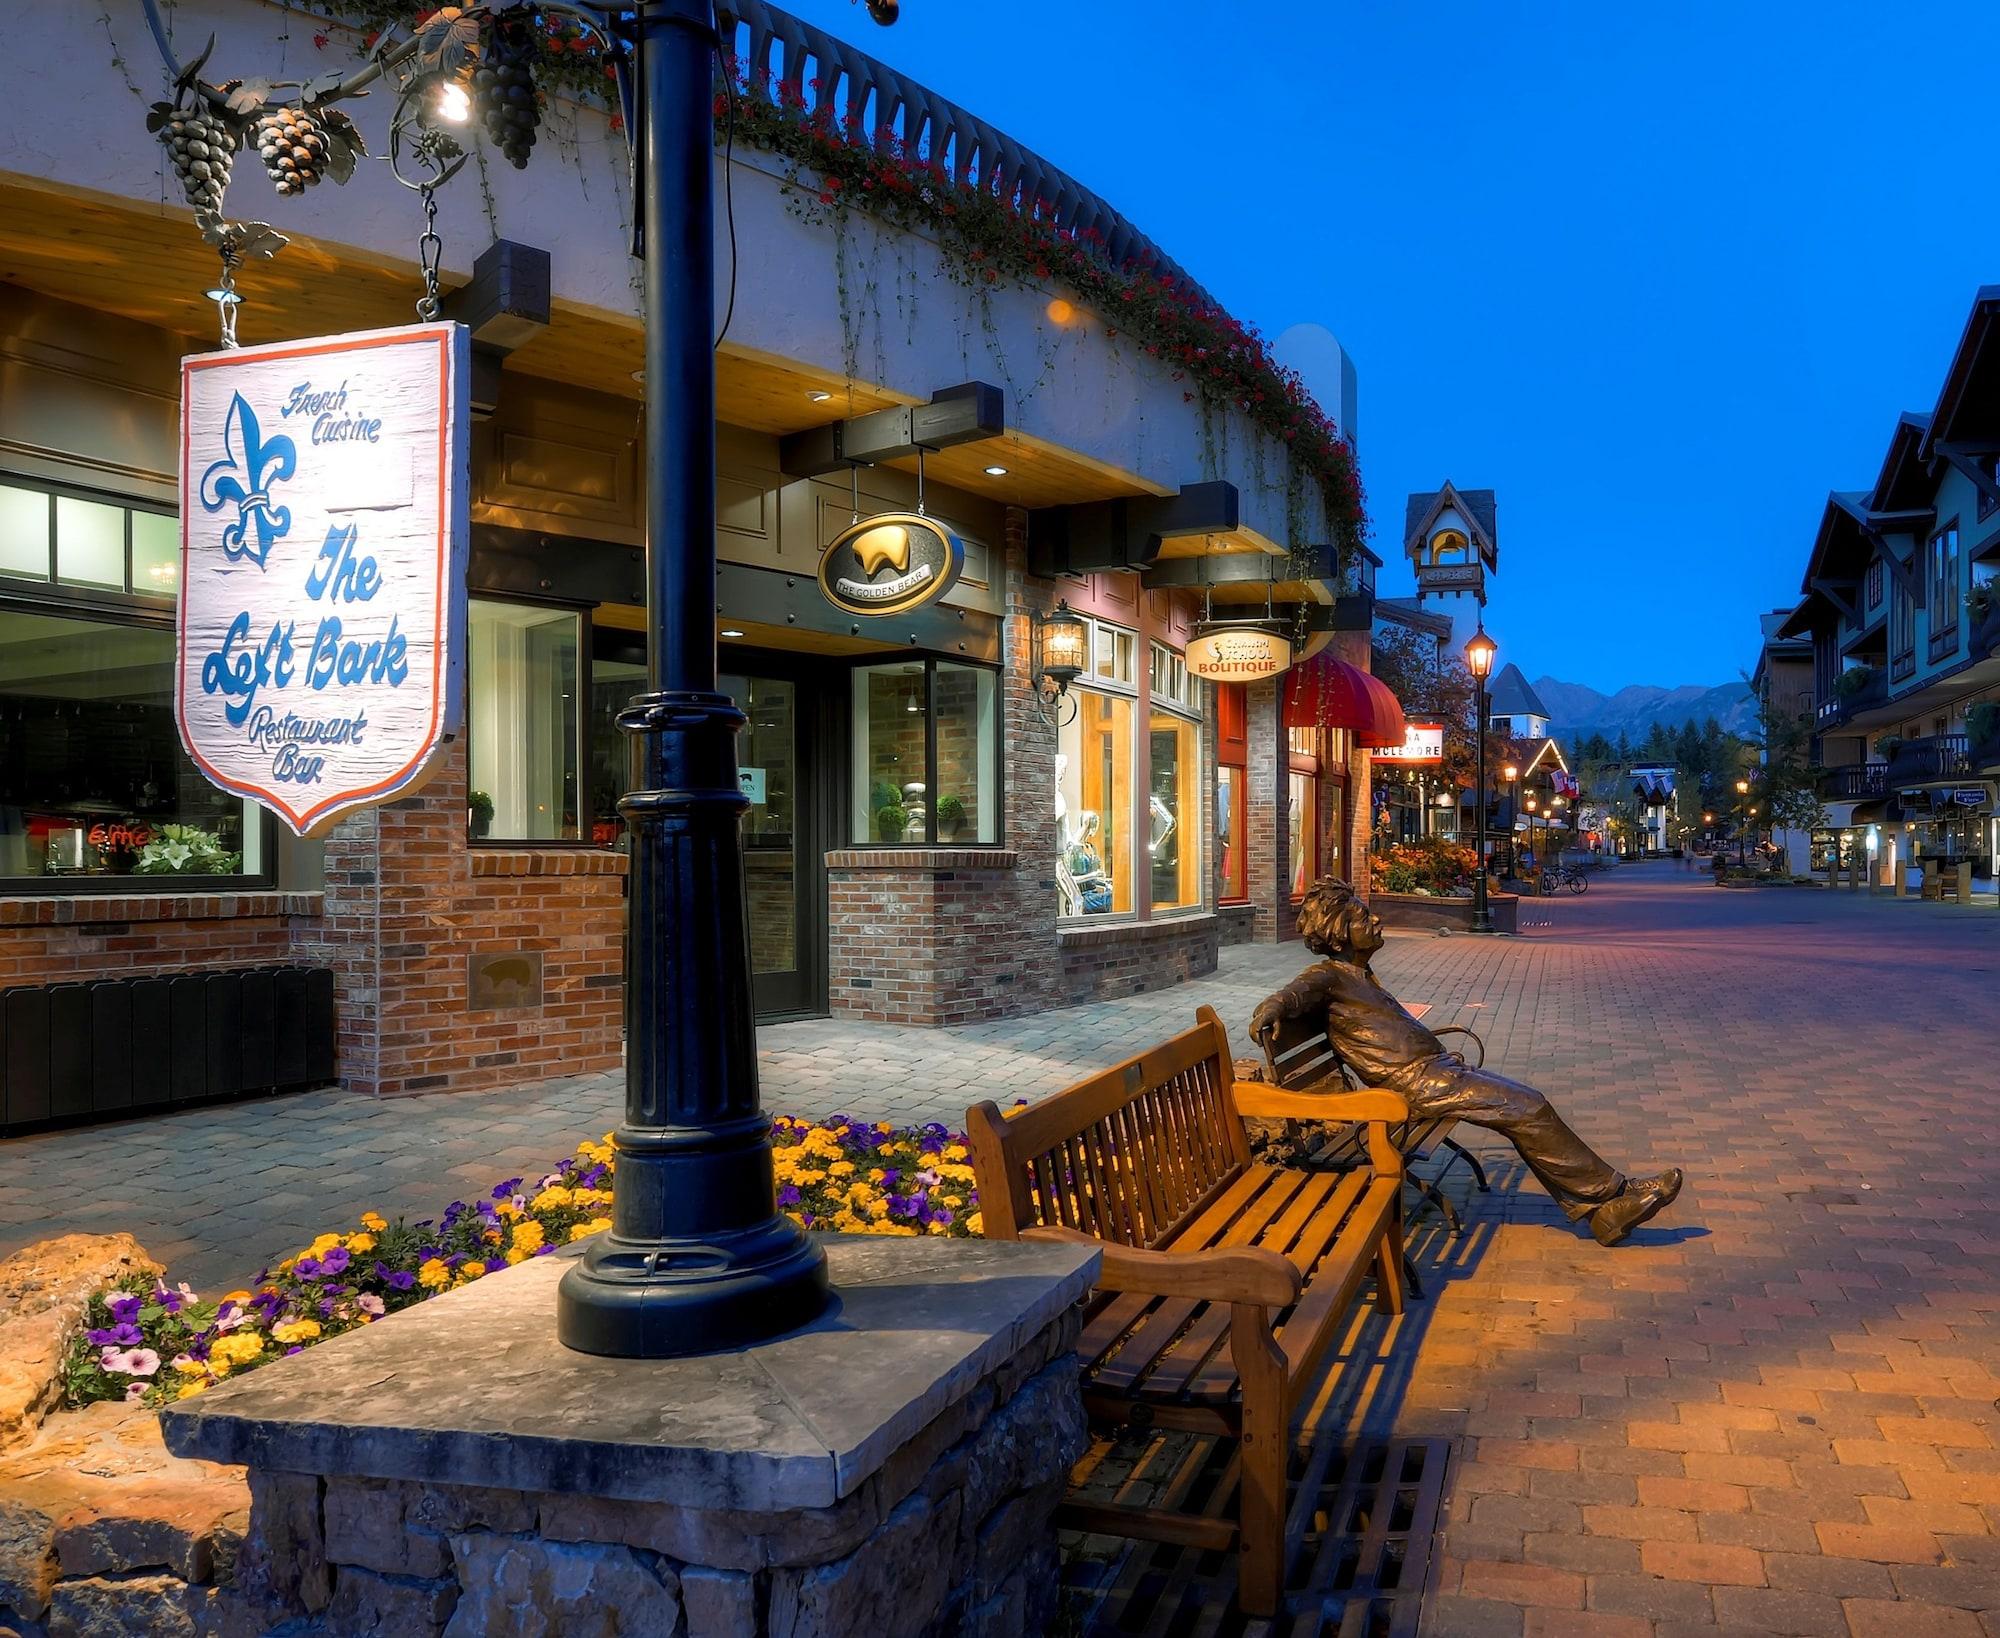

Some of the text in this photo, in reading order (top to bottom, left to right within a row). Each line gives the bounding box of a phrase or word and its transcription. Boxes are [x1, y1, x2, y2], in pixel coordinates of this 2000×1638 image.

[281, 380, 347, 419] French
[312, 411, 382, 446] Cuisine
[305, 523, 383, 603] The
[838, 572, 922, 597] THE GOLDEN BEAR
[202, 611, 408, 728] Left Bank
[1198, 661, 1277, 673] BOUTIQUE
[249, 706, 368, 753] Restaurant
[272, 742, 326, 784] Bar
